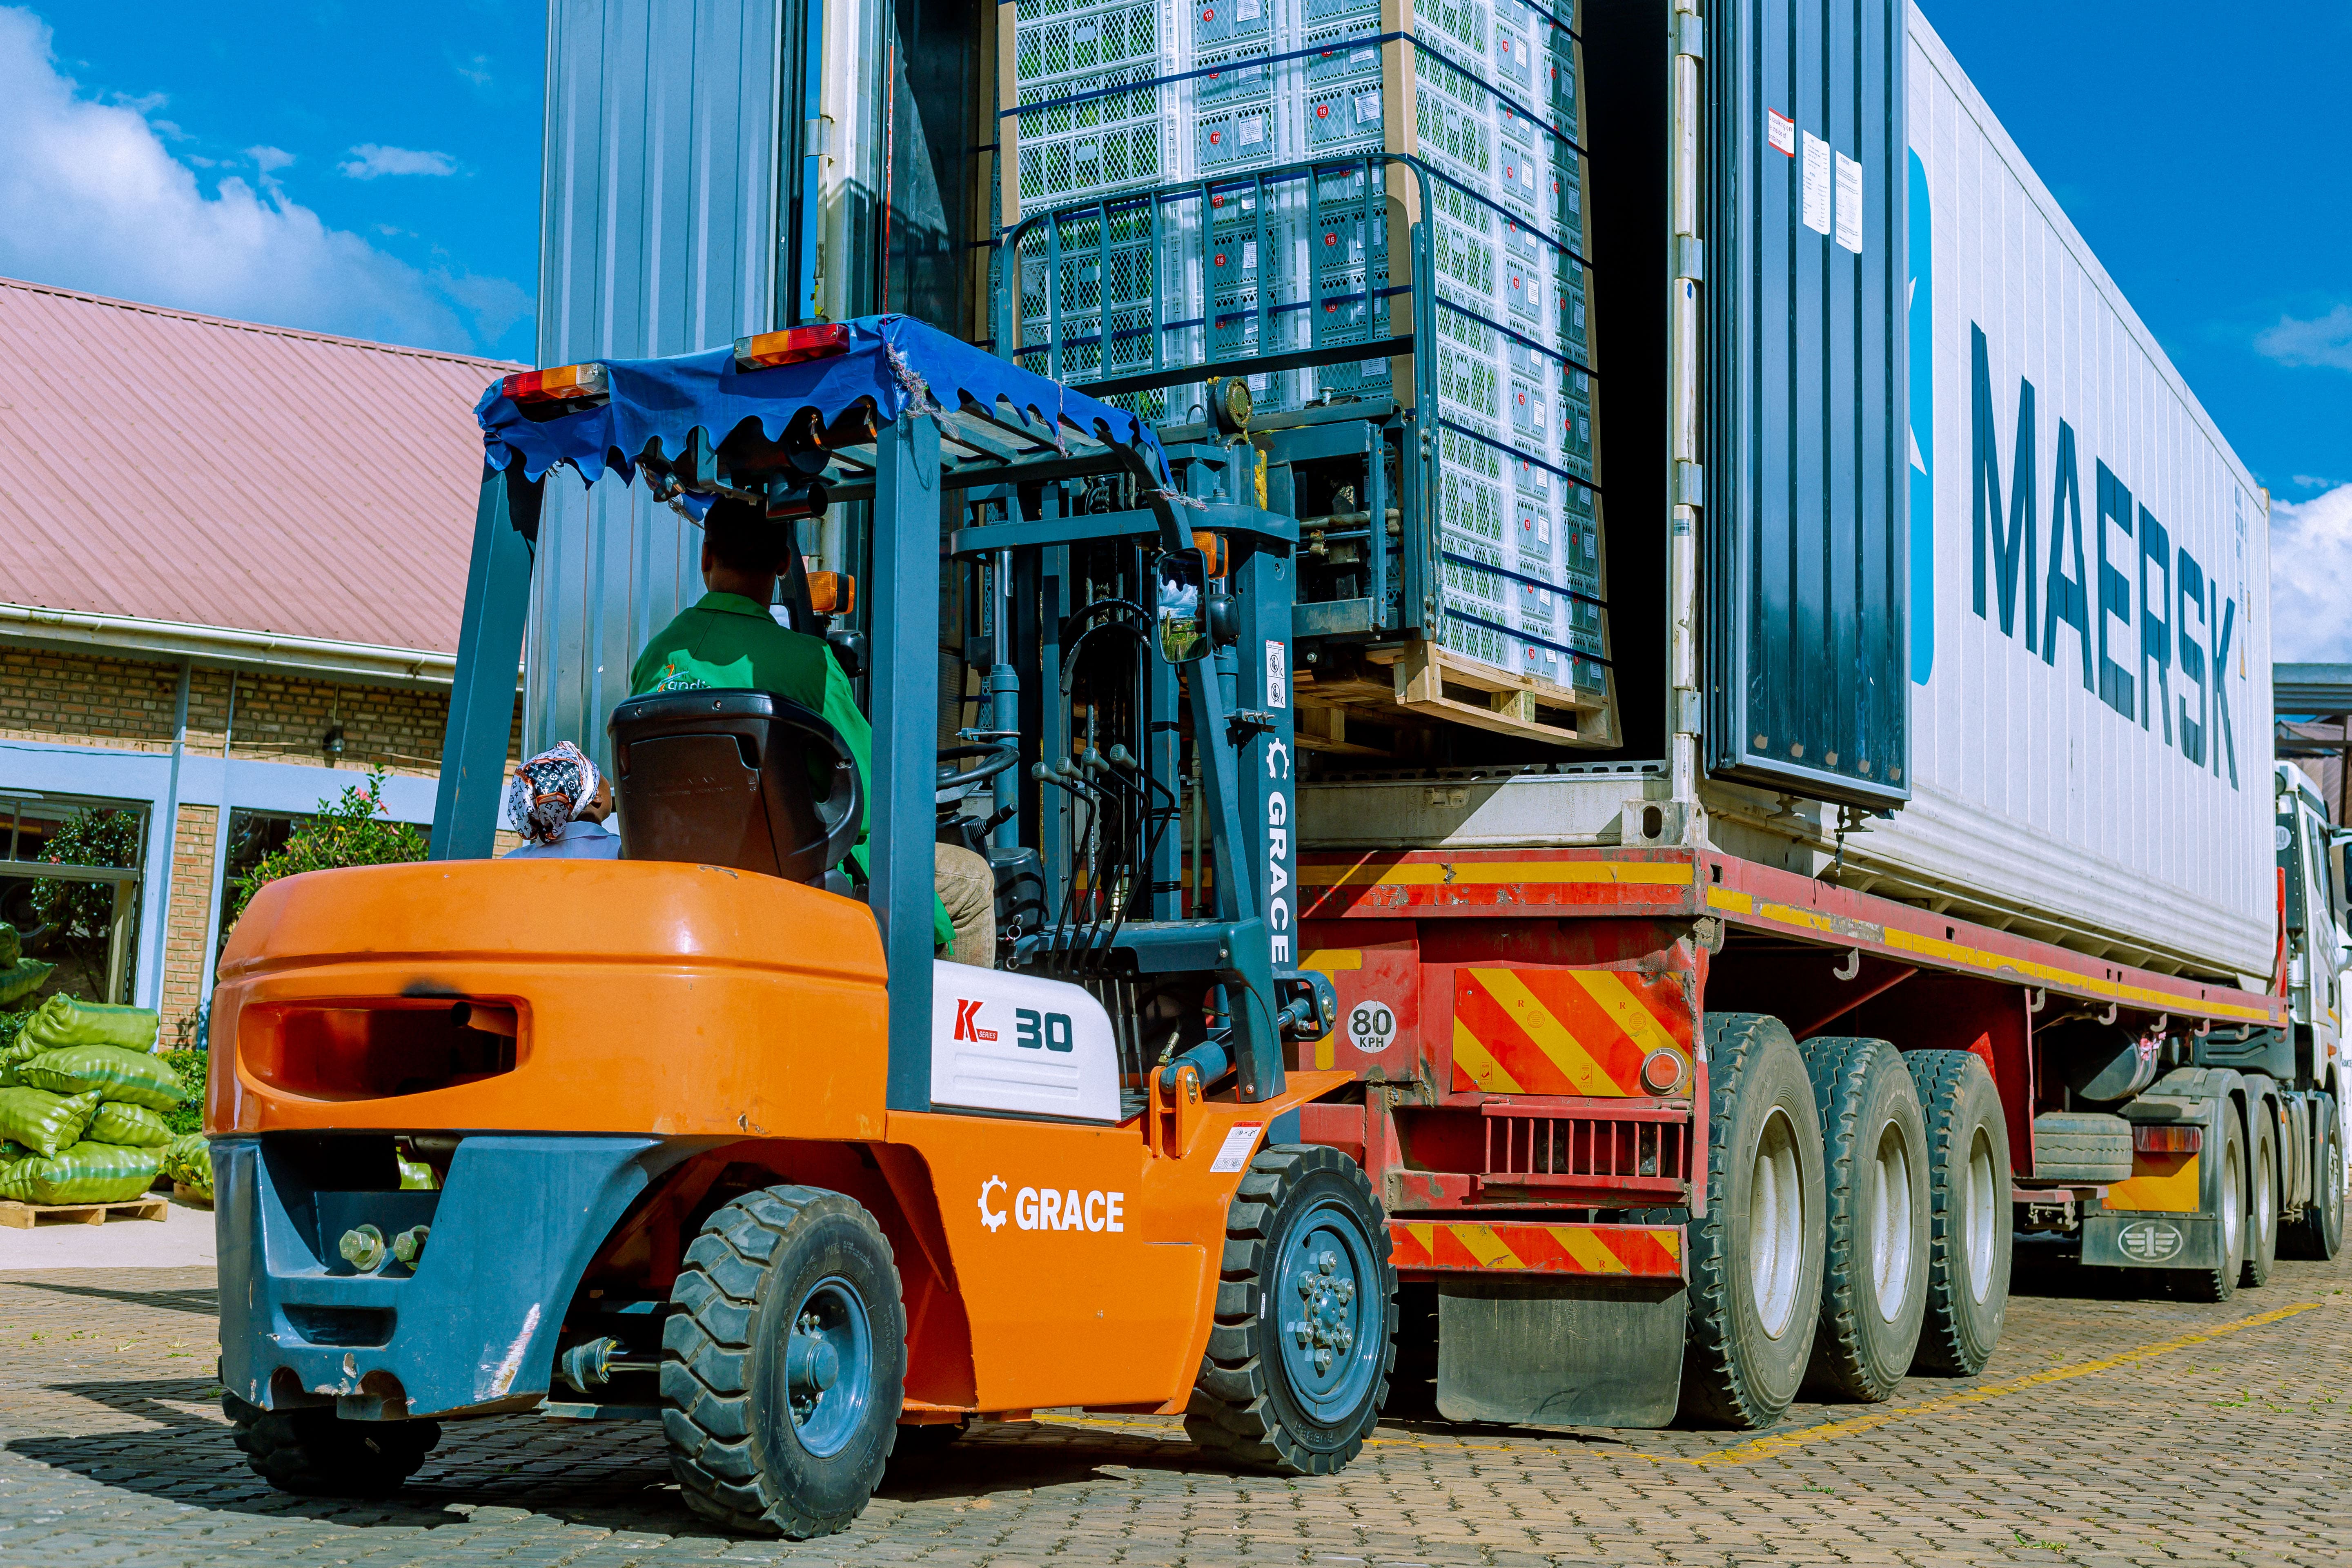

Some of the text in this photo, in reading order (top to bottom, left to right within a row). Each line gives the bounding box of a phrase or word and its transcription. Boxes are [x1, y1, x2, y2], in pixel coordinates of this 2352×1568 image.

[1768, 134, 1782, 145] ontainer
[1772, 117, 1786, 131] caulking
[1773, 126, 1782, 137] inside
[1971, 320, 2238, 791] MAERSK
[1268, 791, 1289, 964] GRACE
[954, 999, 996, 1042] K SERIES
[1016, 1008, 1073, 1053] 30
[1352, 1009, 1392, 1036] 80
[1359, 1037, 1384, 1048] KPH
[1015, 1187, 1124, 1232] GRACE
